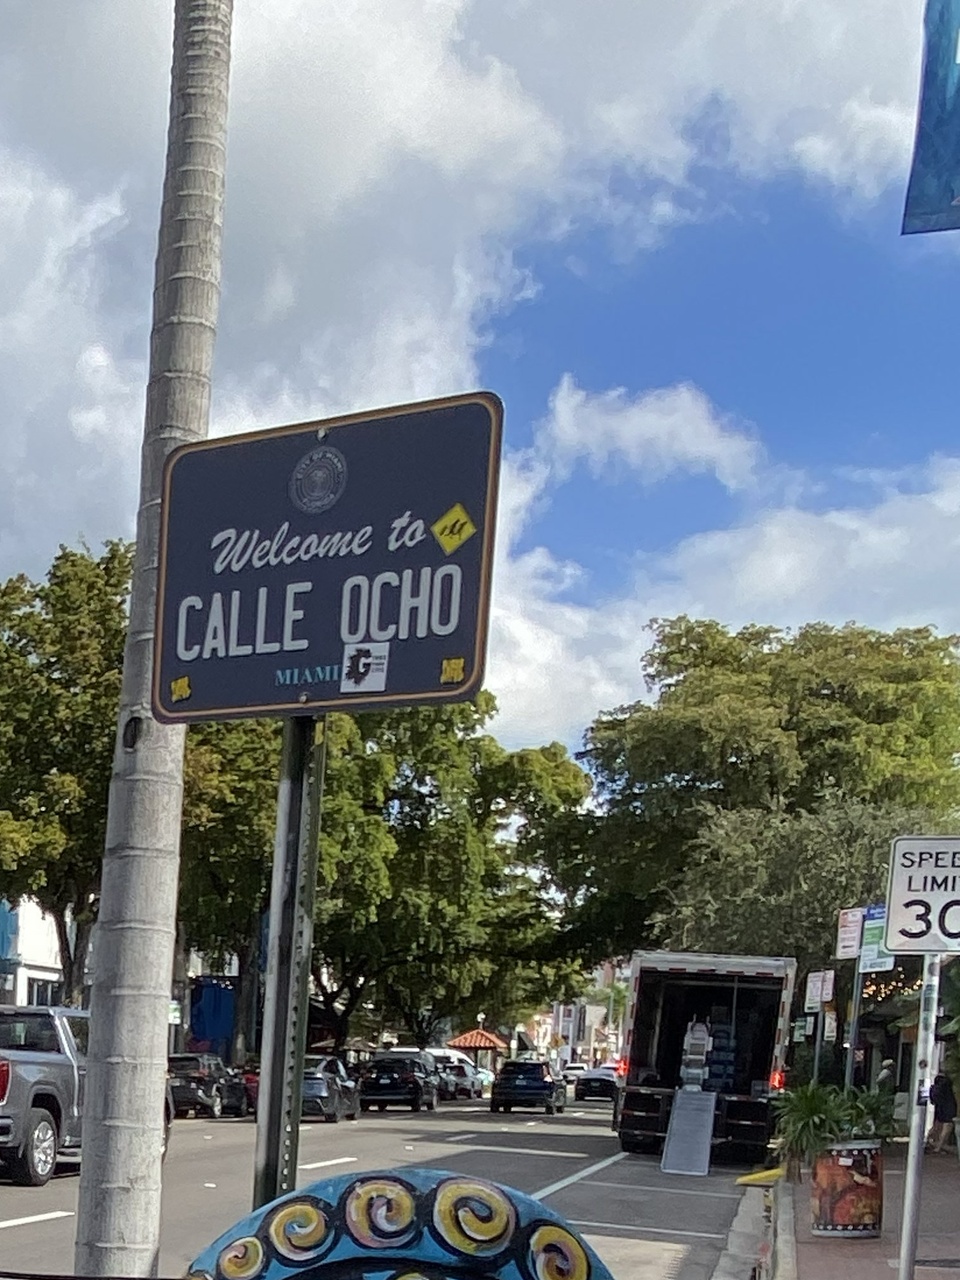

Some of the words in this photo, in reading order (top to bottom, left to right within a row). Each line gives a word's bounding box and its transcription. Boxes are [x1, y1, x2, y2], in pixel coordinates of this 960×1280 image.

[211, 521, 373, 574] Welcome
[388, 510, 426, 551] to
[177, 582, 313, 661] CALLE
[340, 564, 462, 644] OCHO
[275, 664, 340, 686] MIAMI
[907, 875, 960, 892] LIMI
